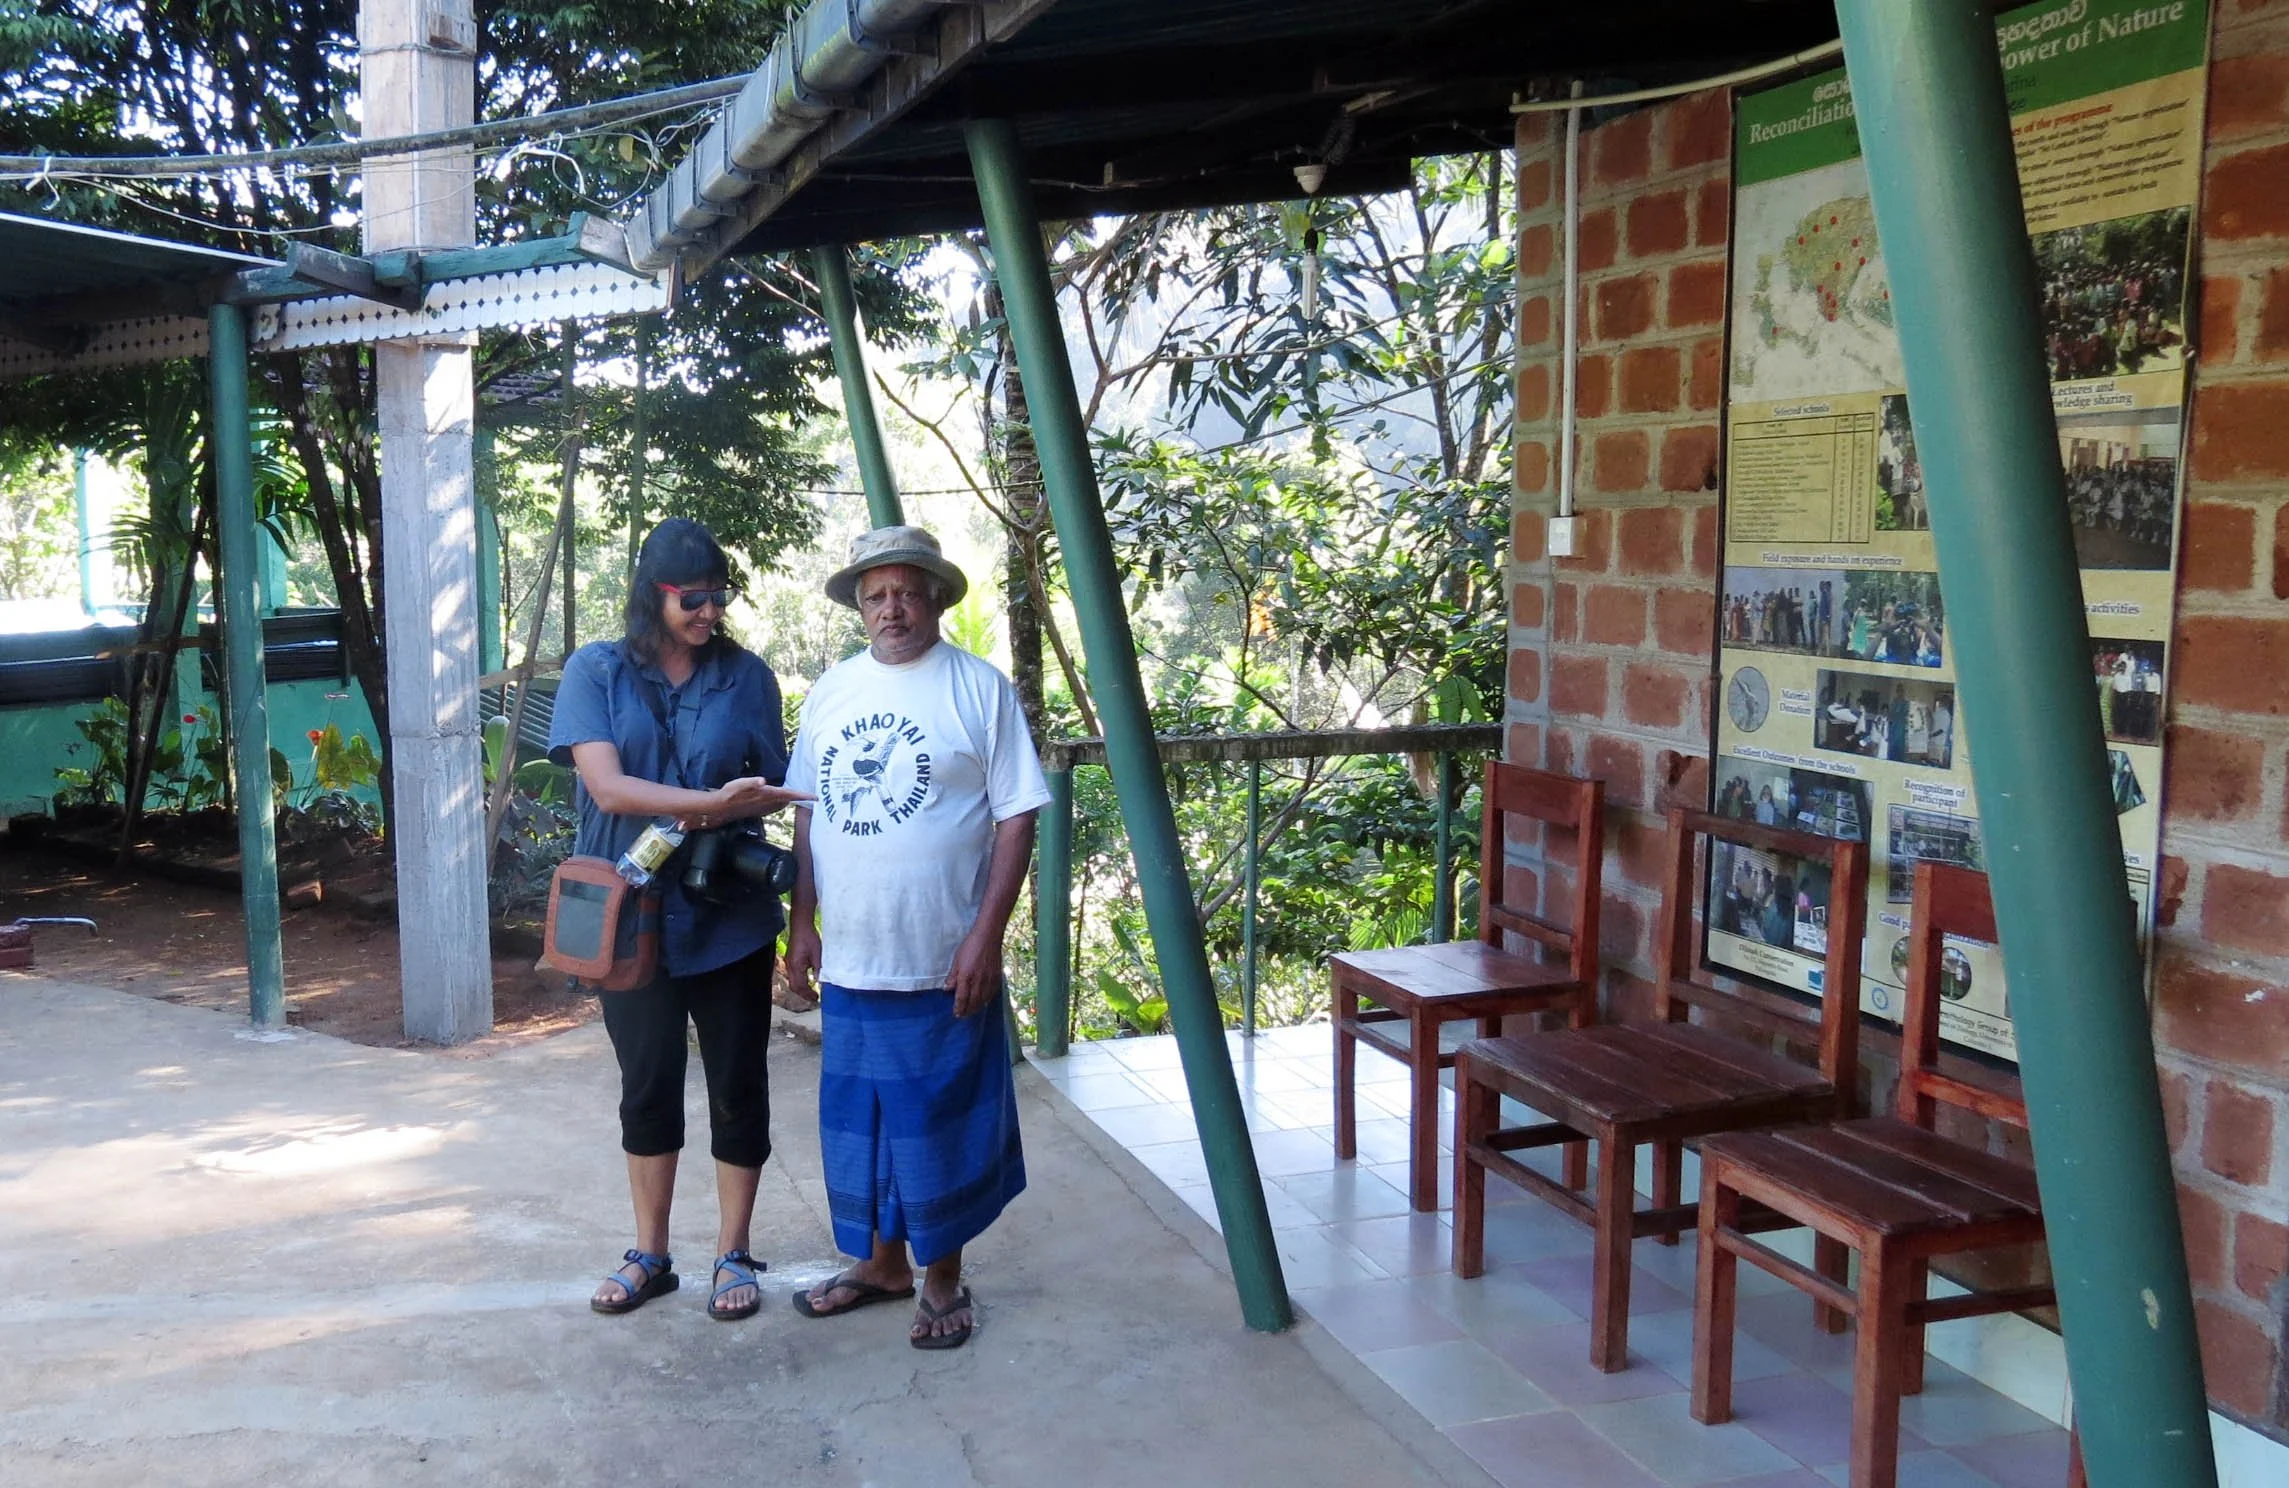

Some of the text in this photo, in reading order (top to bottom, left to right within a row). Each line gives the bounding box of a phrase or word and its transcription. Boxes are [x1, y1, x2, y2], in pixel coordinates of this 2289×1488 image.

[1747, 98, 1855, 144] Reconciliatio
[2001, 38, 2062, 70] ower
[2065, 21, 2093, 52] of
[2097, 2, 2184, 43] Nature
[2036, 118, 2052, 130] the
[2055, 104, 2112, 128] programme
[2095, 380, 2114, 393] and
[1802, 402, 1830, 414] schools
[2054, 394, 2133, 410] wledge sharing
[1763, 552, 1779, 563] Field
[1812, 554, 1826, 564] and
[1862, 555, 1903, 567] experience
[2091, 602, 2140, 615] activities
[841, 713, 926, 746] KHAO YAI
[1816, 759, 1828, 769] the
[1829, 763, 1857, 775] schools
[820, 746, 839, 823] NATIONAL
[842, 819, 883, 836] PARK
[889, 753, 931, 824] THAILAND
[1904, 779, 1966, 798] Recognition of
[1912, 794, 1958, 809] participant
[1879, 912, 1900, 926] Good
